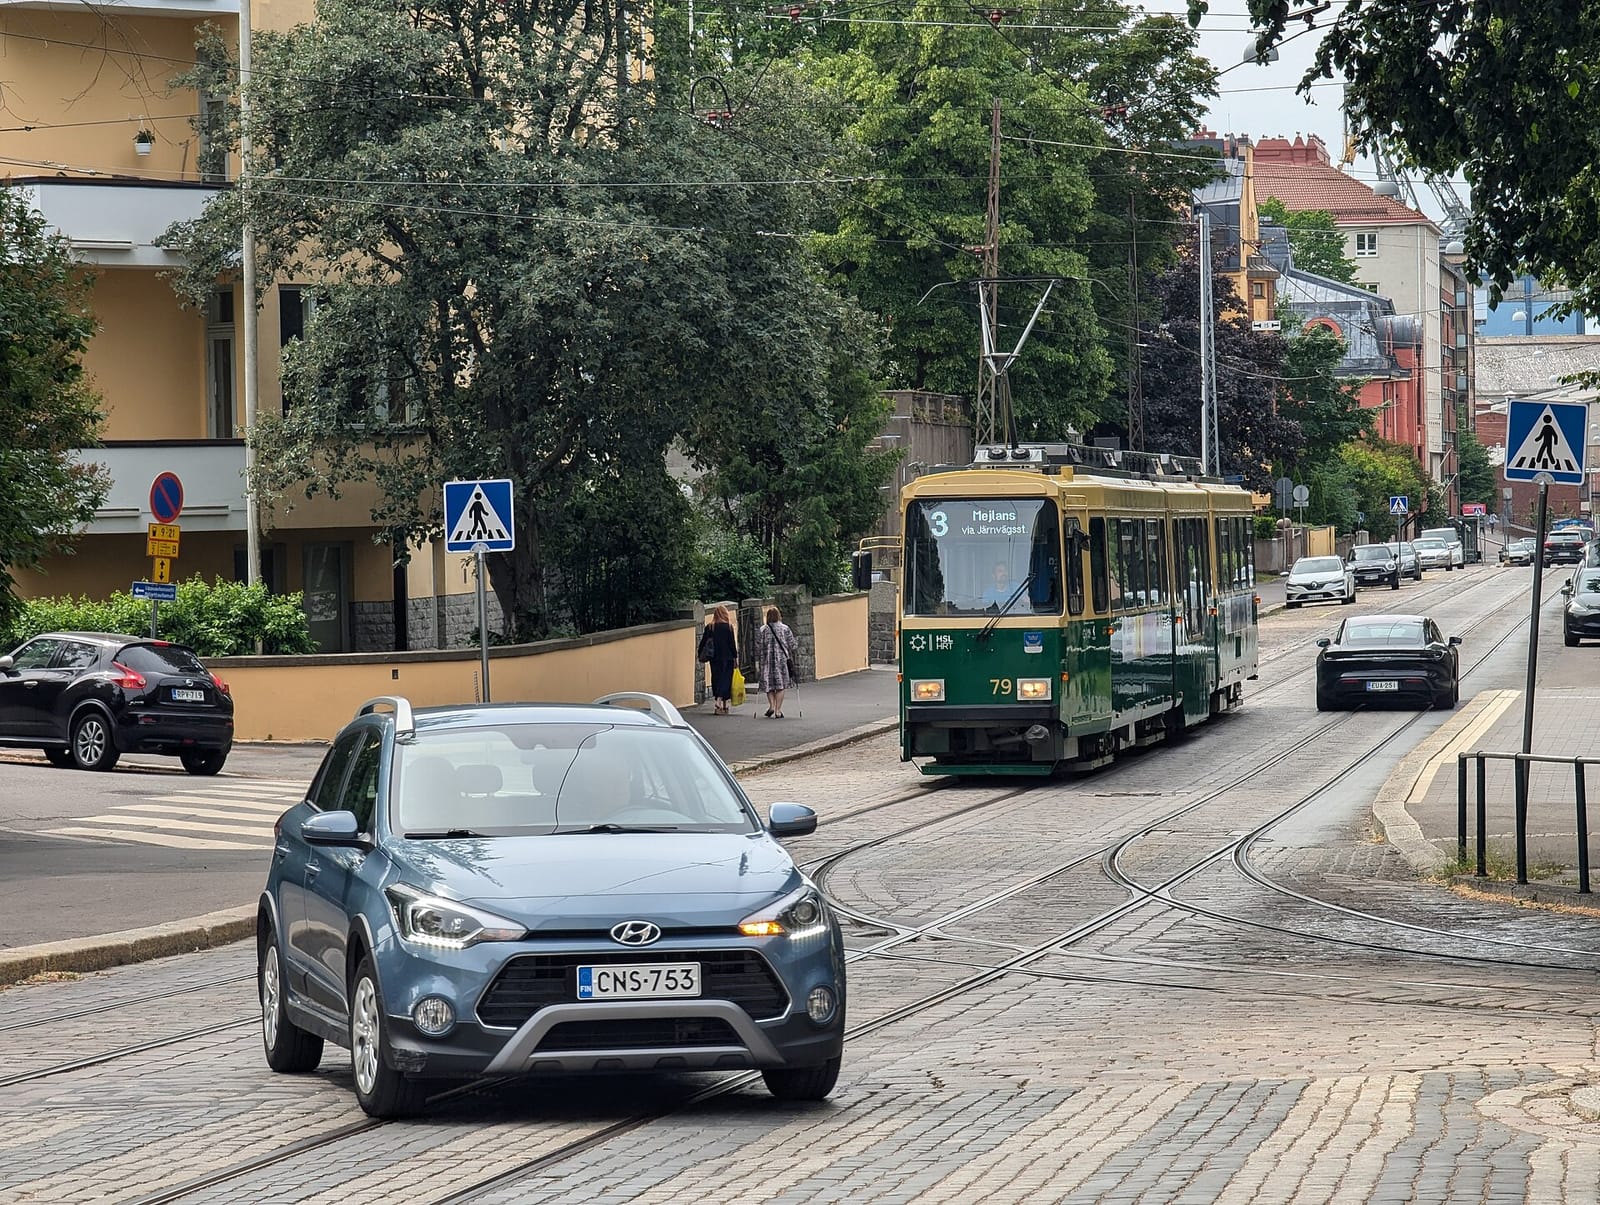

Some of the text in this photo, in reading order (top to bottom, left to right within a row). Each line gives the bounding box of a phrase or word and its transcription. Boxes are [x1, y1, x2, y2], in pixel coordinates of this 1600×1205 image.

[972, 510, 1017, 523] Mejlans
[931, 511, 949, 537] 3
[961, 524, 1029, 536] via Järnvägsst.
[936, 635, 953, 643] HSL
[936, 642, 953, 650] HRT
[989, 678, 1012, 695] 79
[597, 968, 694, 993] CNS-753
[580, 985, 592, 993] FIN
